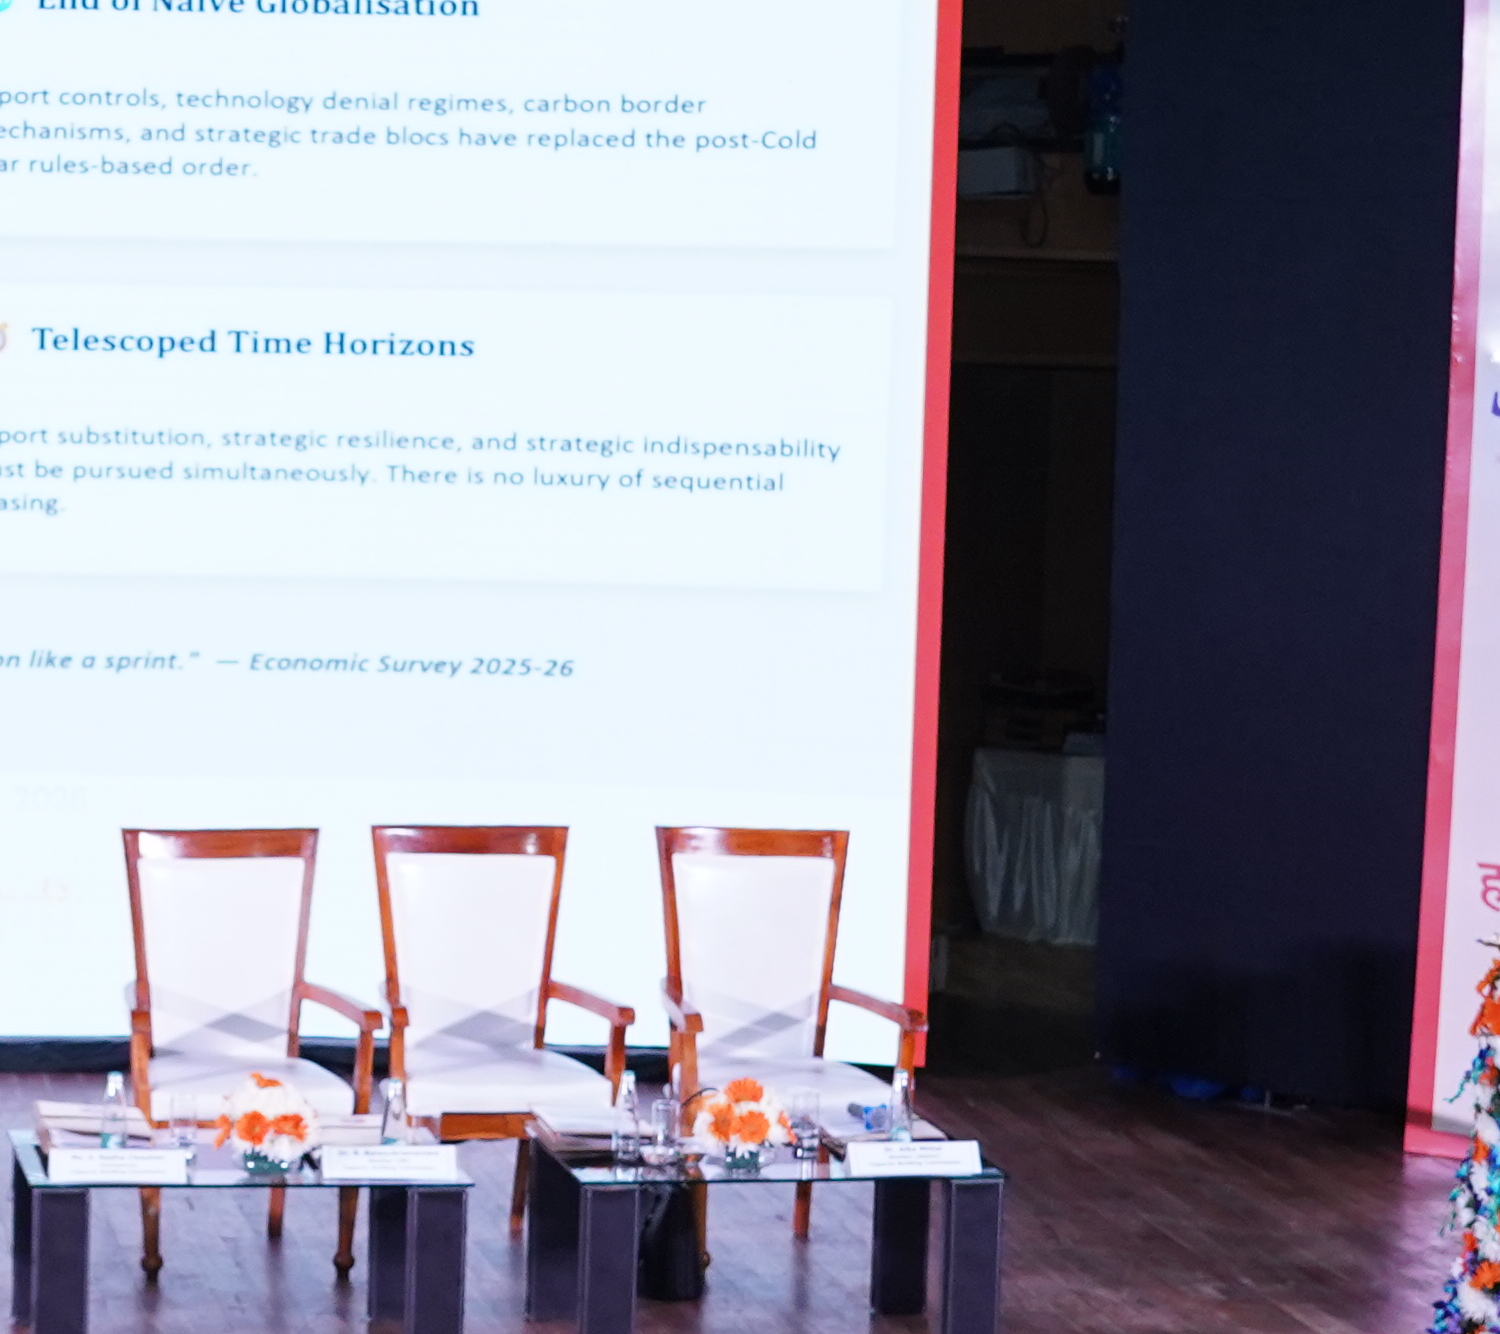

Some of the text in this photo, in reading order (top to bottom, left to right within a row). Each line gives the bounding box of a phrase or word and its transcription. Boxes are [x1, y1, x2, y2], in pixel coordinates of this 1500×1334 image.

[58, 87, 167, 111] controls,
[175, 88, 314, 115] technology
[321, 90, 399, 111] denial
[407, 94, 514, 117] regimes,
[522, 93, 611, 114] carbon
[620, 93, 707, 115] border
[139, 122, 186, 143] and
[194, 126, 301, 149] strategic
[309, 125, 377, 146] trade
[385, 125, 450, 147] blocs
[458, 126, 518, 147] have
[526, 127, 636, 152] replaced
[644, 128, 687, 149] the
[695, 129, 817, 154] post-Cold
[28, 153, 173, 176] rules-based
[181, 156, 257, 177] order.
[31, 327, 475, 359] Telescoped Time Horizons
[57, 425, 212, 449] substitution,
[221, 430, 328, 453] strategic
[336, 429, 462, 453] resilience,
[471, 431, 518, 452] and
[526, 435, 634, 459] strategic
[643, 435, 842, 464] indispensability
[34, 459, 64, 479] be
[72, 460, 174, 483] pursued
[182, 461, 376, 487] simultaneously.
[386, 464, 458, 485] There
[467, 467, 485, 485] is
[493, 471, 525, 486] no
[533, 466, 611, 492] luxury
[617, 467, 645, 489] of
[651, 471, 785, 494] sequential
[28, 649, 74, 670] like
[80, 655, 97, 670] a
[249, 652, 370, 673] Economic
[377, 654, 463, 679] Survey
[469, 656, 575, 678] 2025-26
